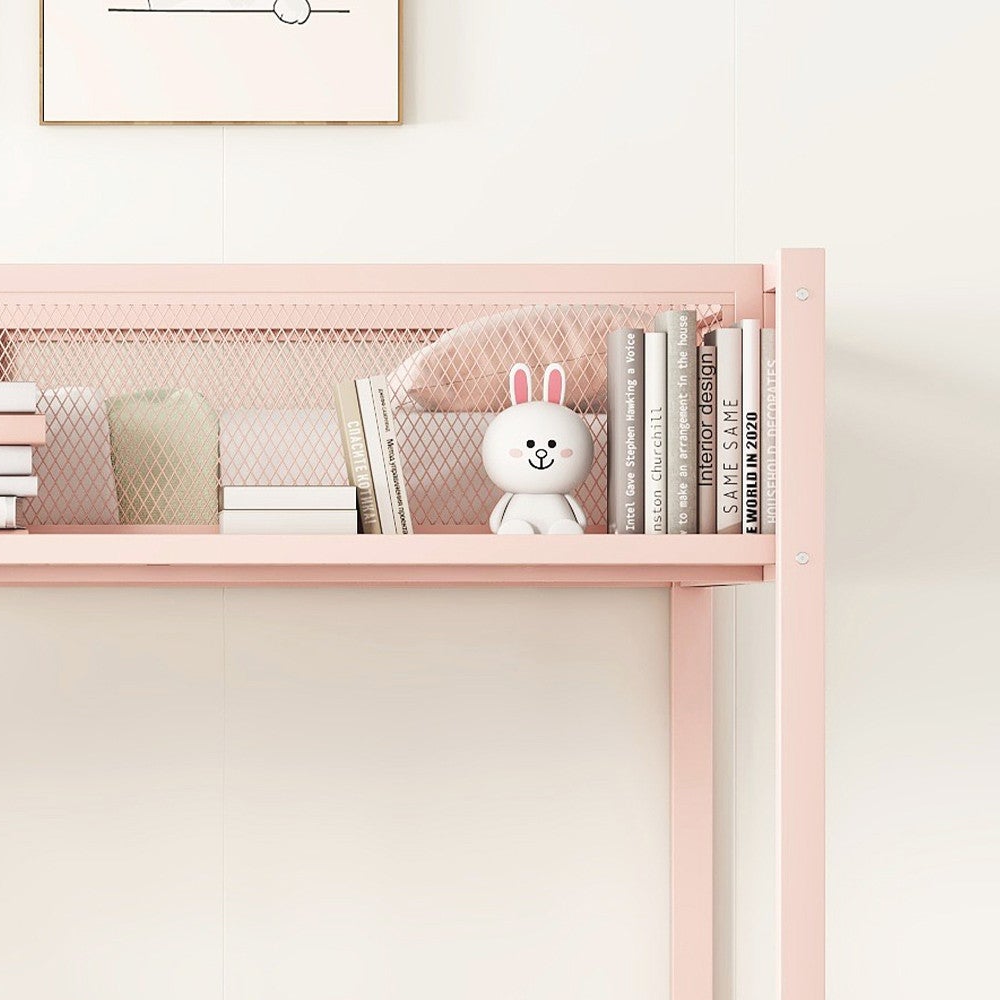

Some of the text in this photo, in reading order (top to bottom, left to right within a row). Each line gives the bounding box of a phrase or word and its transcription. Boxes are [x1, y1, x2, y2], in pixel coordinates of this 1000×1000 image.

[677, 315, 688, 346] house
[625, 333, 635, 363] Voice
[677, 352, 688, 369] the
[677, 375, 688, 388] in
[625, 380, 637, 420] Hawking
[678, 393, 690, 459] arrangement
[698, 353, 716, 486] Interior design
[746, 412, 757, 449] 2020
[625, 426, 637, 467] Stephen
[651, 407, 662, 481] Churchill
[723, 399, 738, 513] SAME SAME
[680, 465, 688, 477] an
[746, 453, 757, 468] IN
[626, 472, 635, 496] Gave
[677, 483, 688, 507] make
[746, 472, 757, 523] WORLD
[625, 502, 635, 530] Intel
[678, 512, 688, 524] to
